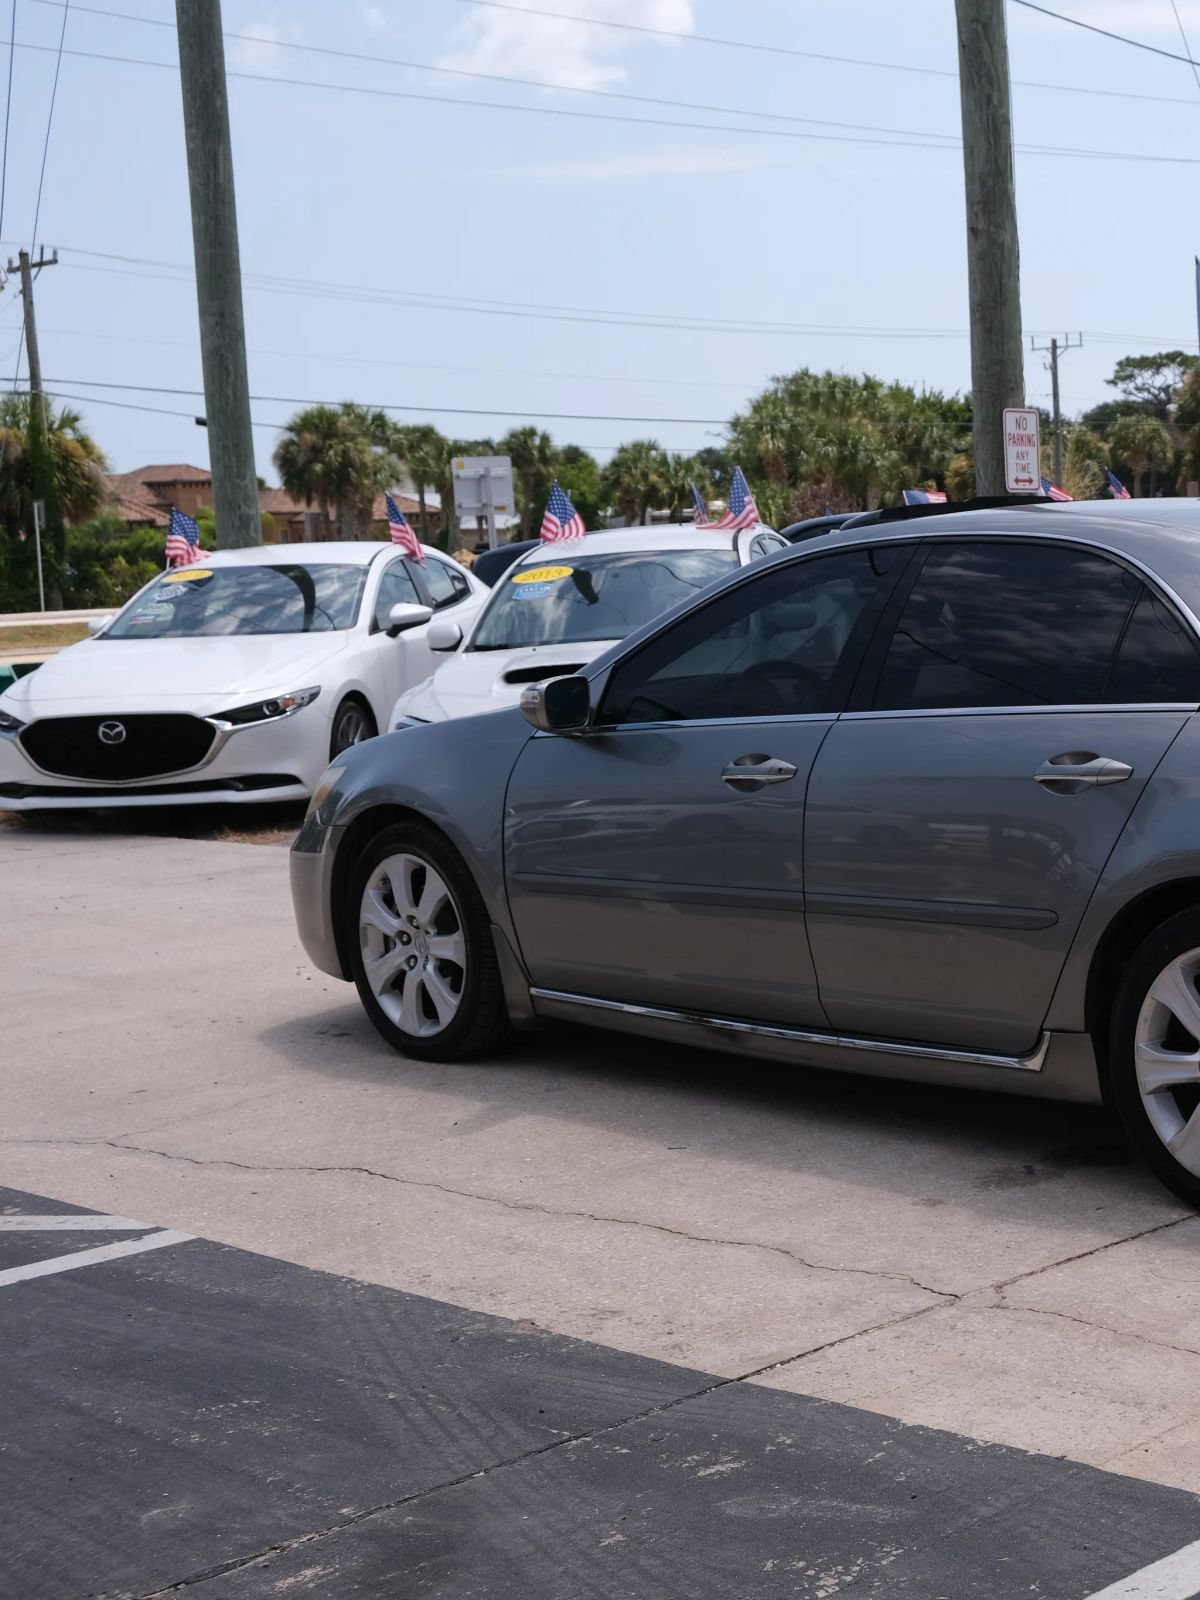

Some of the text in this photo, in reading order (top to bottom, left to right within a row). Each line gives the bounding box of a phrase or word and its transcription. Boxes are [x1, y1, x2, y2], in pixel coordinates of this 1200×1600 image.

[1015, 417, 1028, 431] NO
[1008, 433, 1036, 448] PARKING
[1015, 450, 1030, 461] ANY
[1015, 463, 1031, 473] TIME
